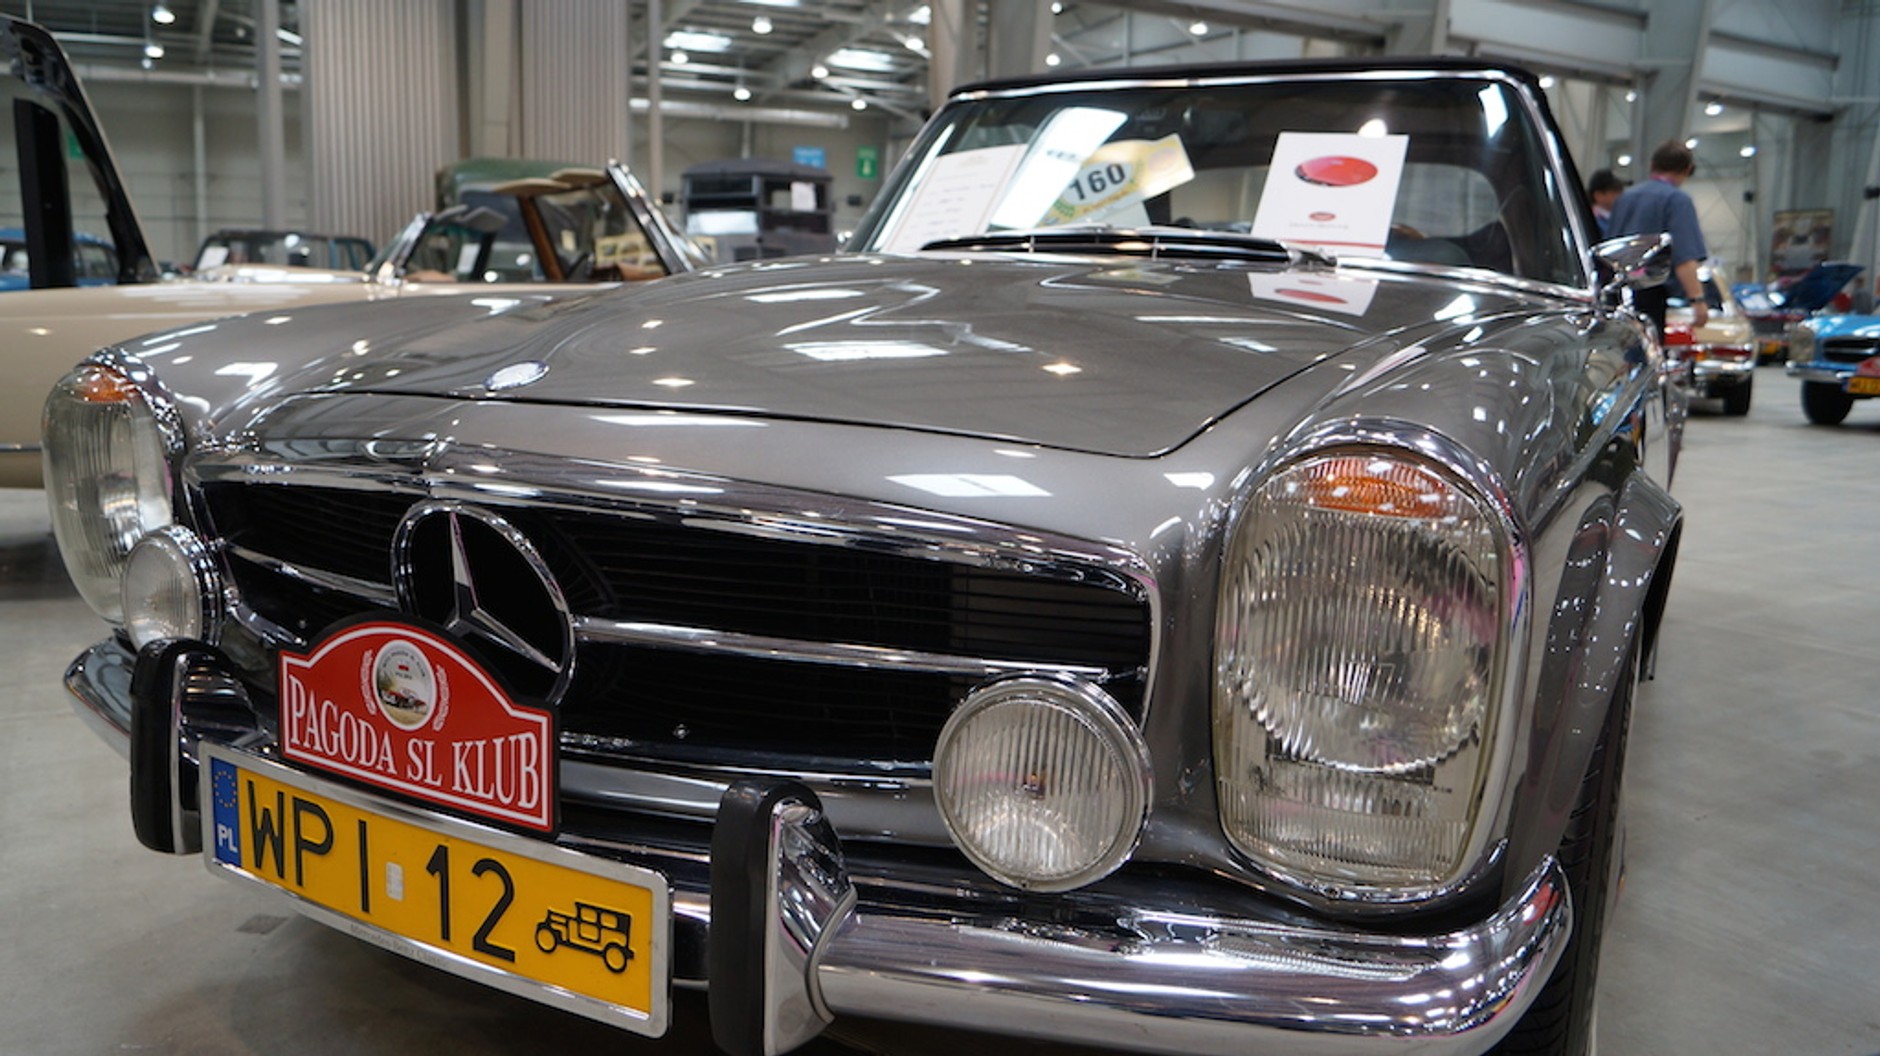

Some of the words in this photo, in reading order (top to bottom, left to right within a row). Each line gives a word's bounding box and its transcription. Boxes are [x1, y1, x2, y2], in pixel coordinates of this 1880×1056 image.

[1070, 163, 1126, 200] 160
[289, 674, 397, 774] PAGODA
[407, 738, 443, 786] SL
[451, 731, 540, 809] KLUB
[217, 823, 239, 853] PL
[426, 844, 515, 963] 12
